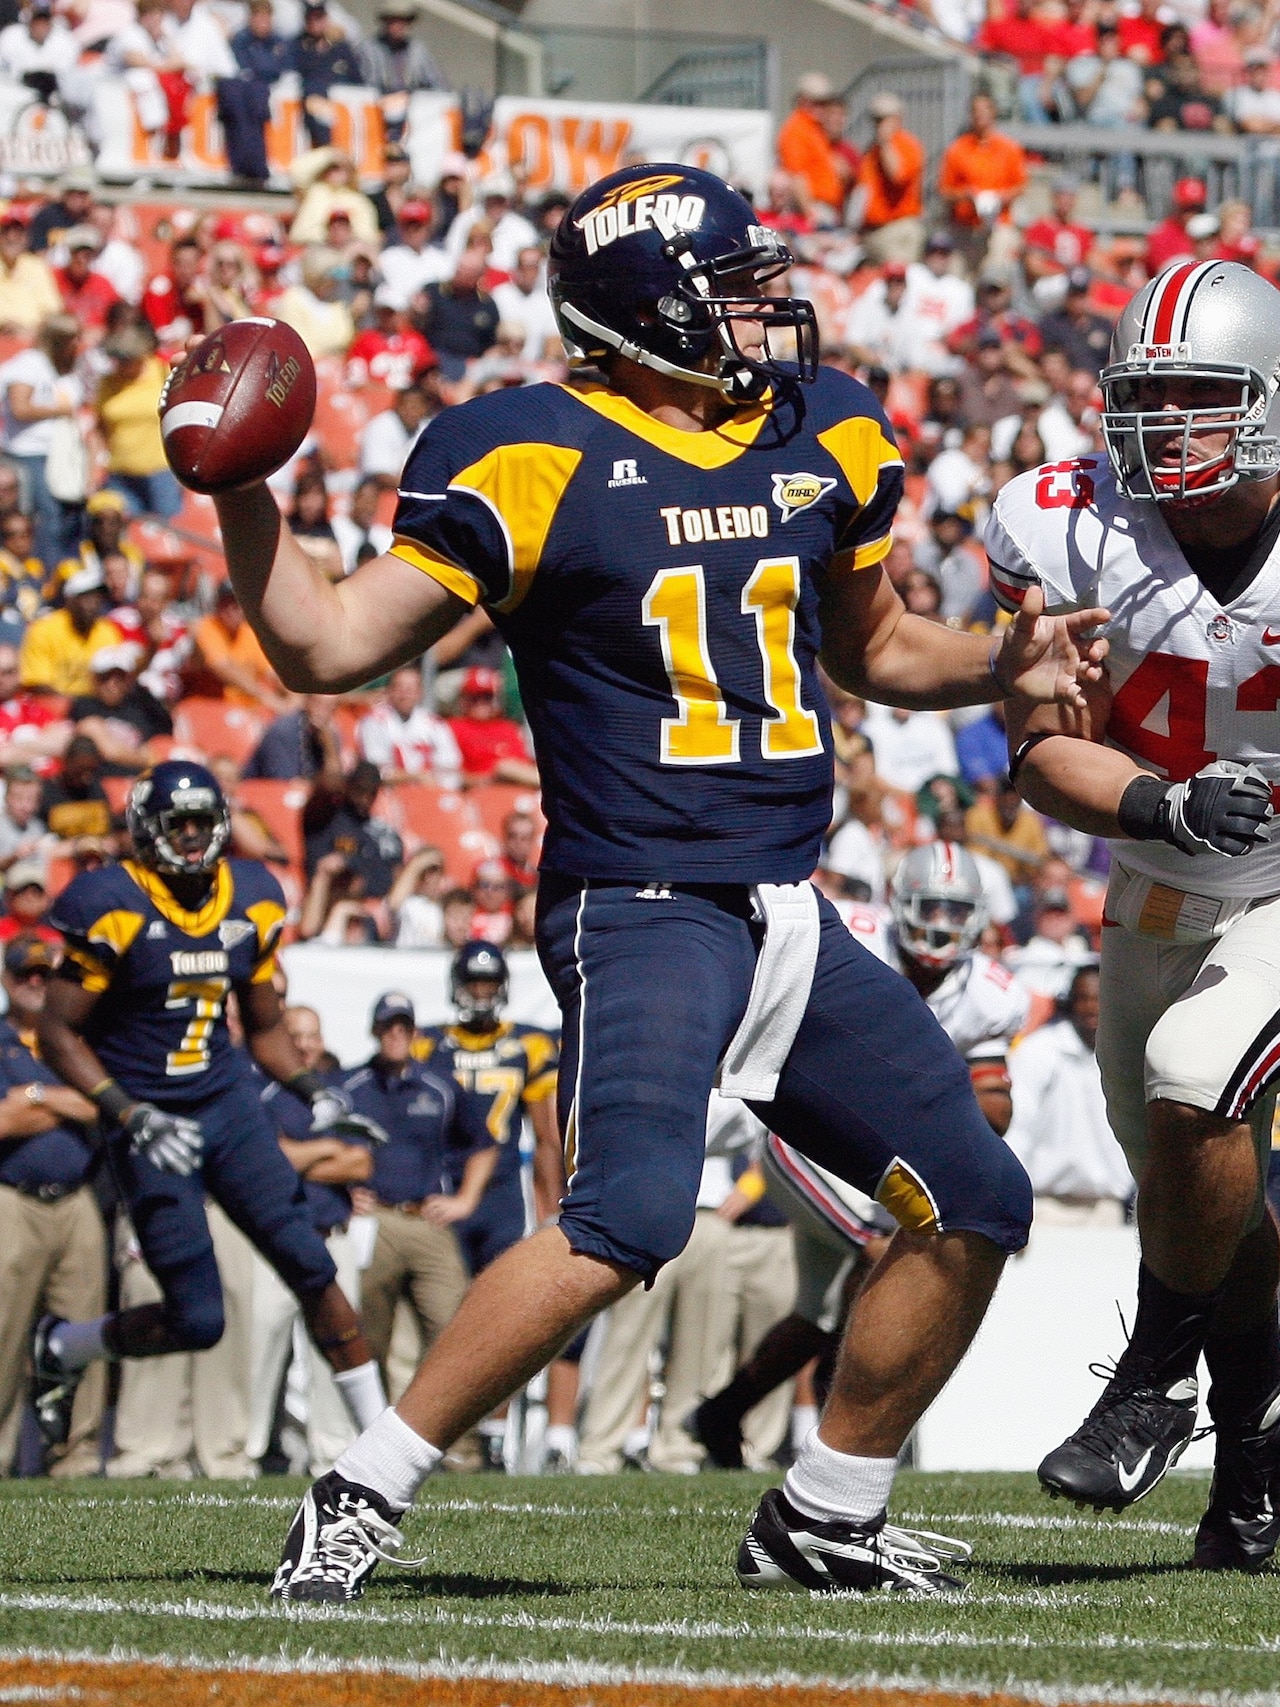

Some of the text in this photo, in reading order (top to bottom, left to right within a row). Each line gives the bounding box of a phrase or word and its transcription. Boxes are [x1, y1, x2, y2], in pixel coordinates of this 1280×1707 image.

[573, 194, 706, 256] TOLEDO
[264, 356, 301, 408] TOLEDO
[607, 476, 648, 489] RUSSELL
[612, 458, 638, 480] R
[787, 488, 815, 498] MAC
[659, 505, 769, 546] TOLEDO
[641, 555, 825, 766] 11
[169, 951, 230, 976] TOLEDO
[164, 976, 232, 1077] 7
